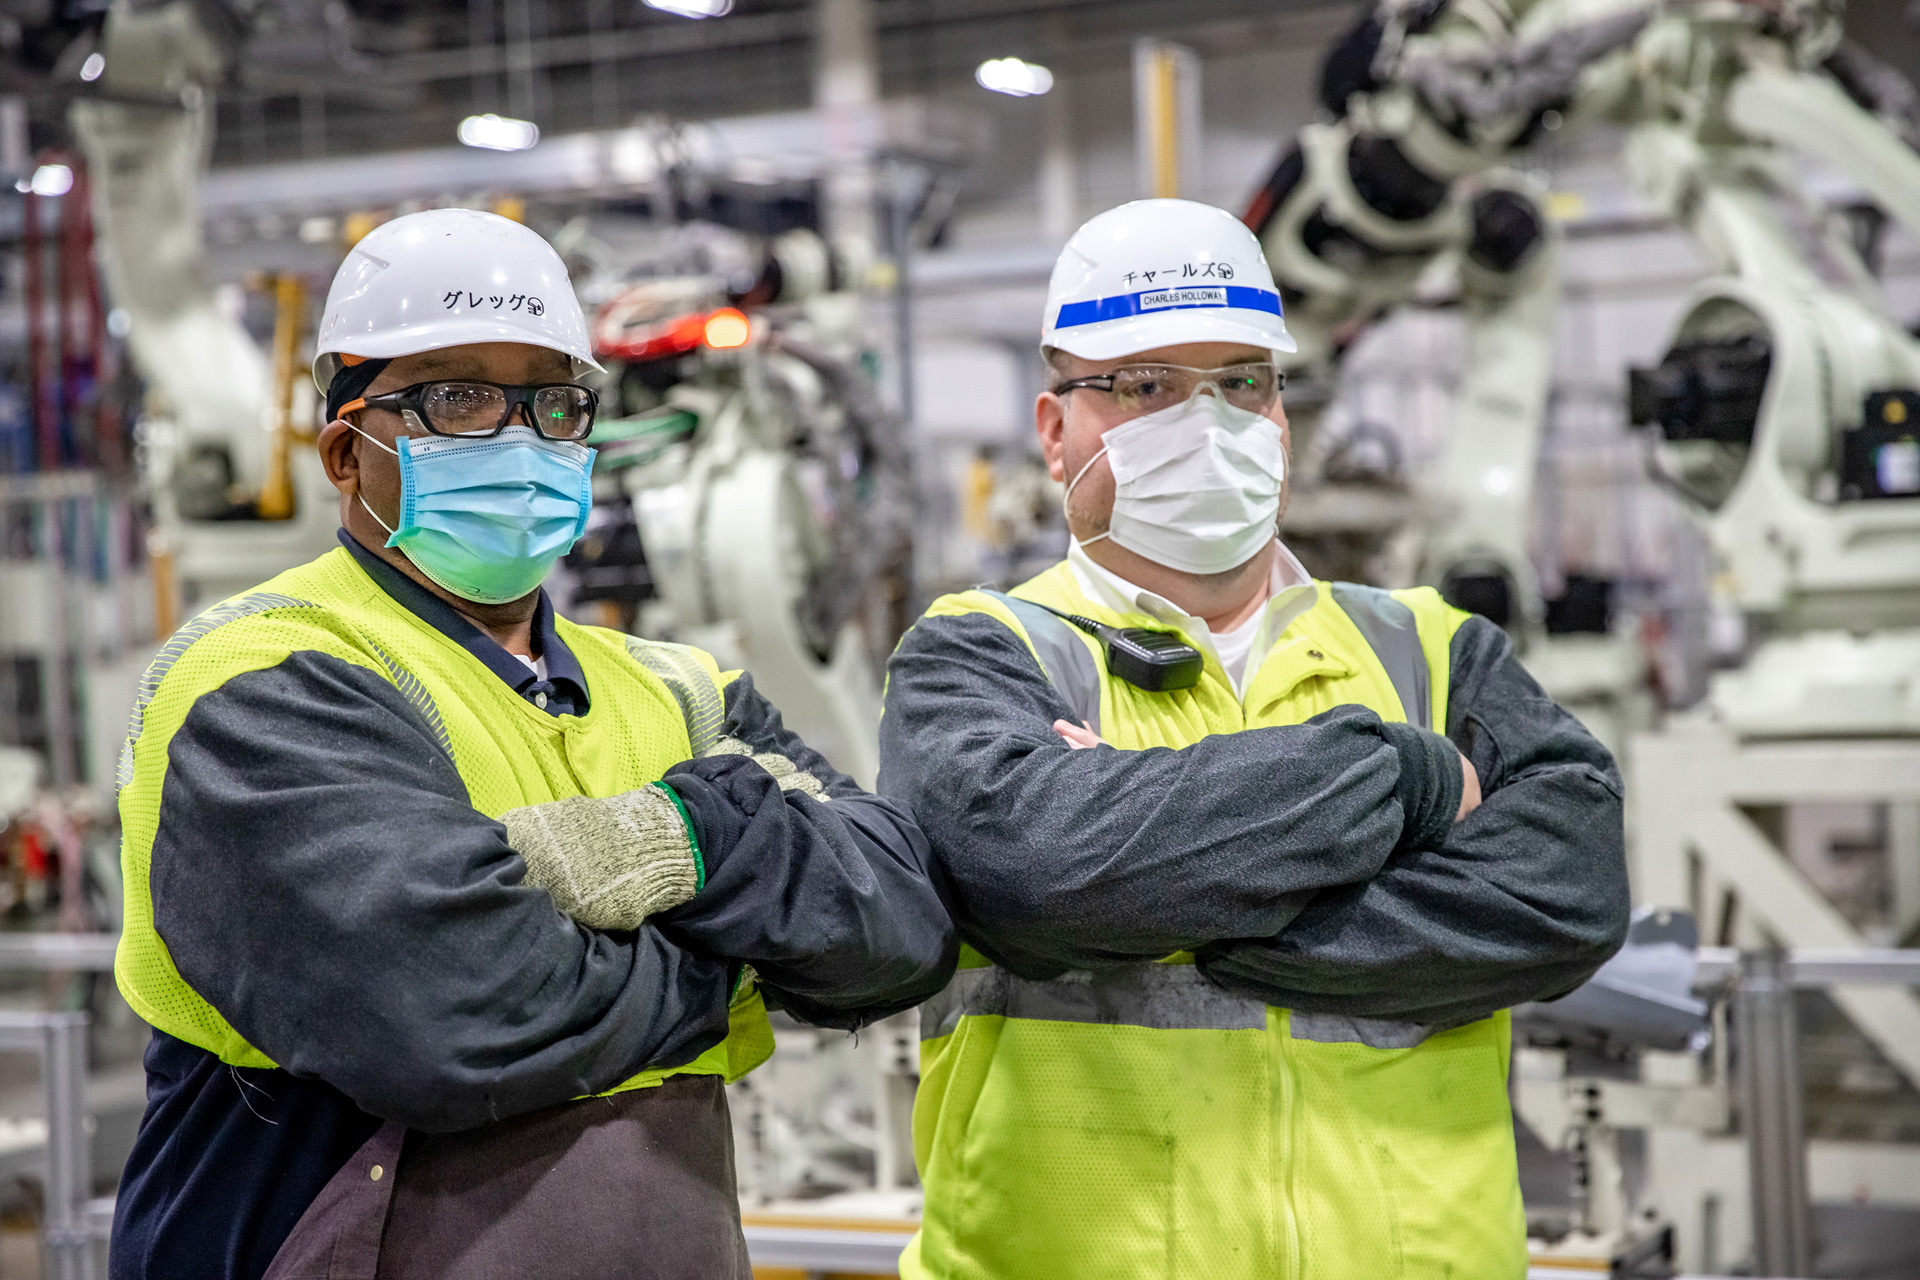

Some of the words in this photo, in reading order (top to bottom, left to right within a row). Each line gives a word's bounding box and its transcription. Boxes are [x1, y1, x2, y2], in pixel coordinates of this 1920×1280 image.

[1122, 262, 1216, 287] チャールズ
[443, 290, 526, 311] グレッグ
[1143, 292, 1180, 305] CHARLES
[1181, 290, 1222, 301] HOLLOWAY
